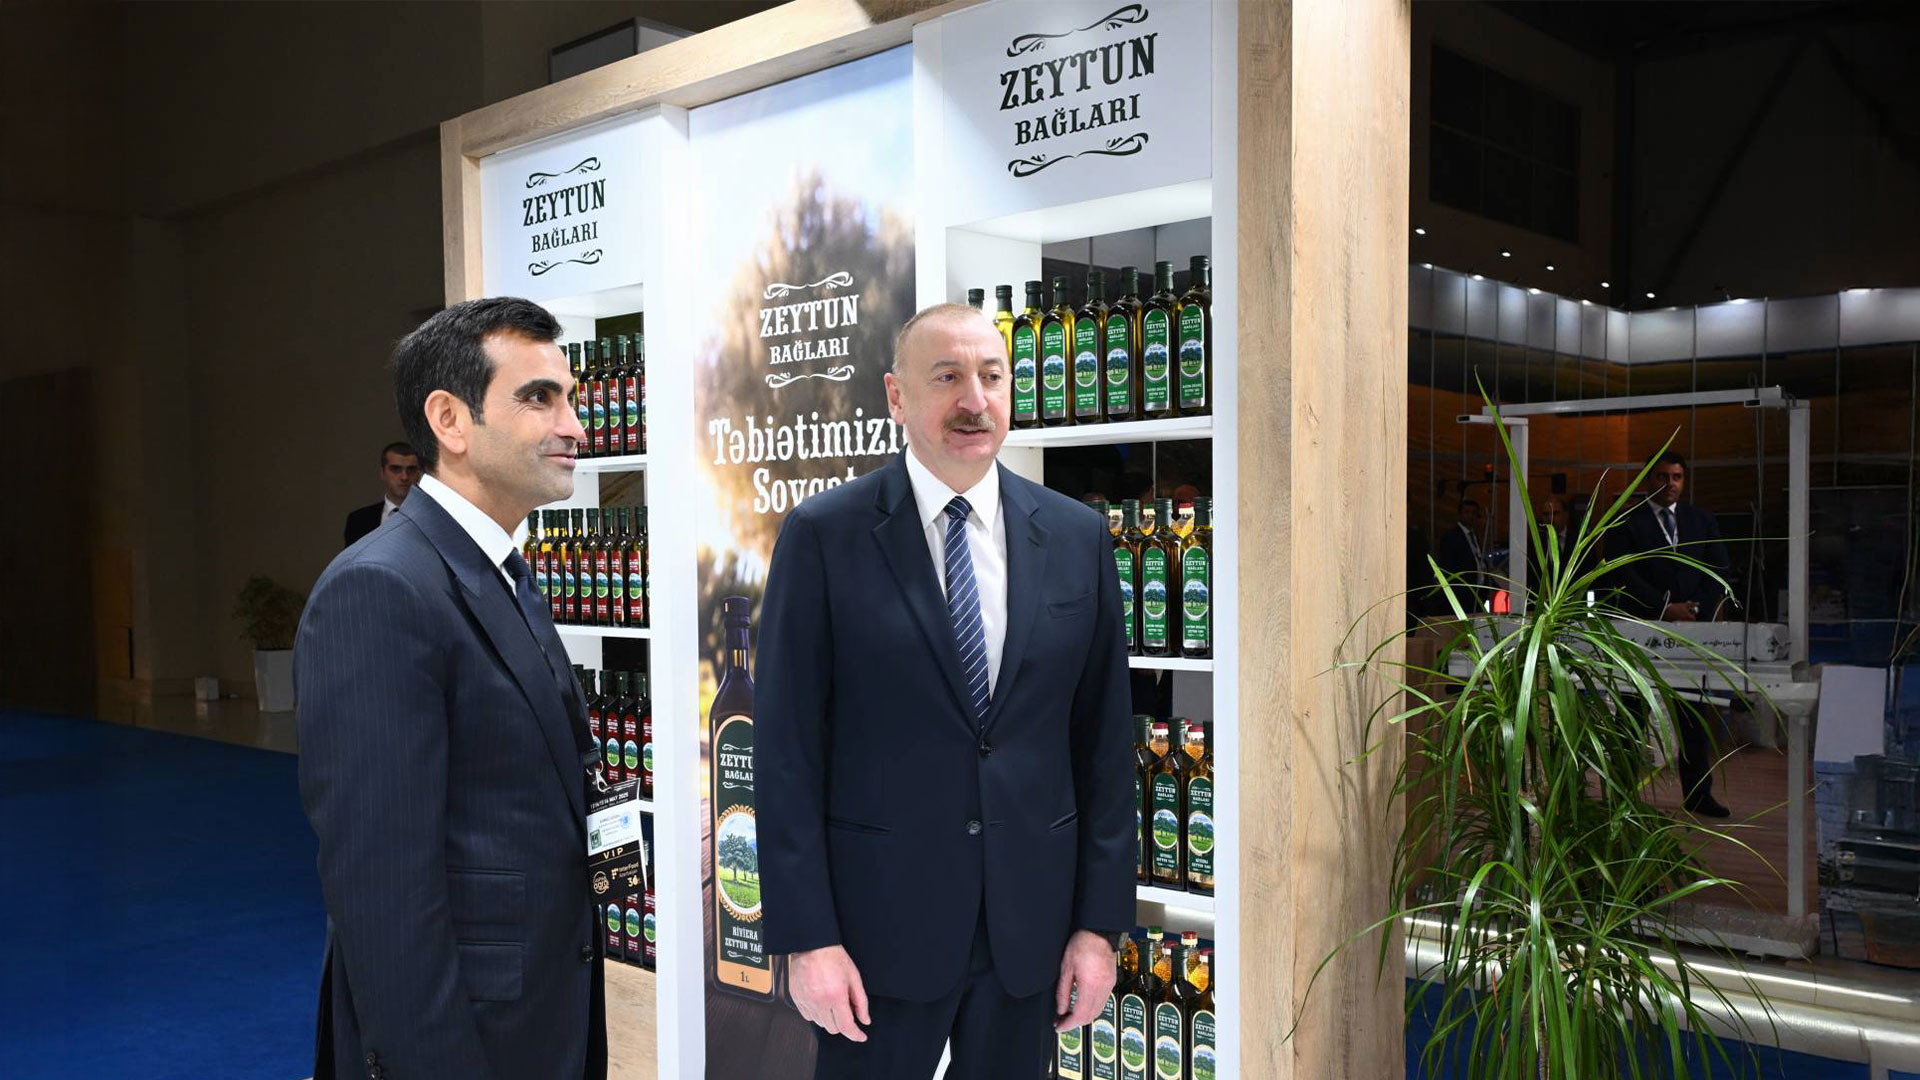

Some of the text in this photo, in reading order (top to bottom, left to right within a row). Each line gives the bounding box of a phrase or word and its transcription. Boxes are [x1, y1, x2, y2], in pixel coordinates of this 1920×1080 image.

[1000, 33, 1158, 111] ZEYTUN
[1015, 94, 1141, 146] BAĞLARI
[523, 179, 606, 226] ZEYTUN
[532, 221, 598, 253] BAĞLARI
[759, 295, 859, 338] ZEYTUN
[769, 337, 850, 365] BAĞLARI
[720, 753, 753, 769] ZEYTU
[603, 847, 624, 859] VIP
[725, 937, 763, 953] ZEYTUN YAĞ
